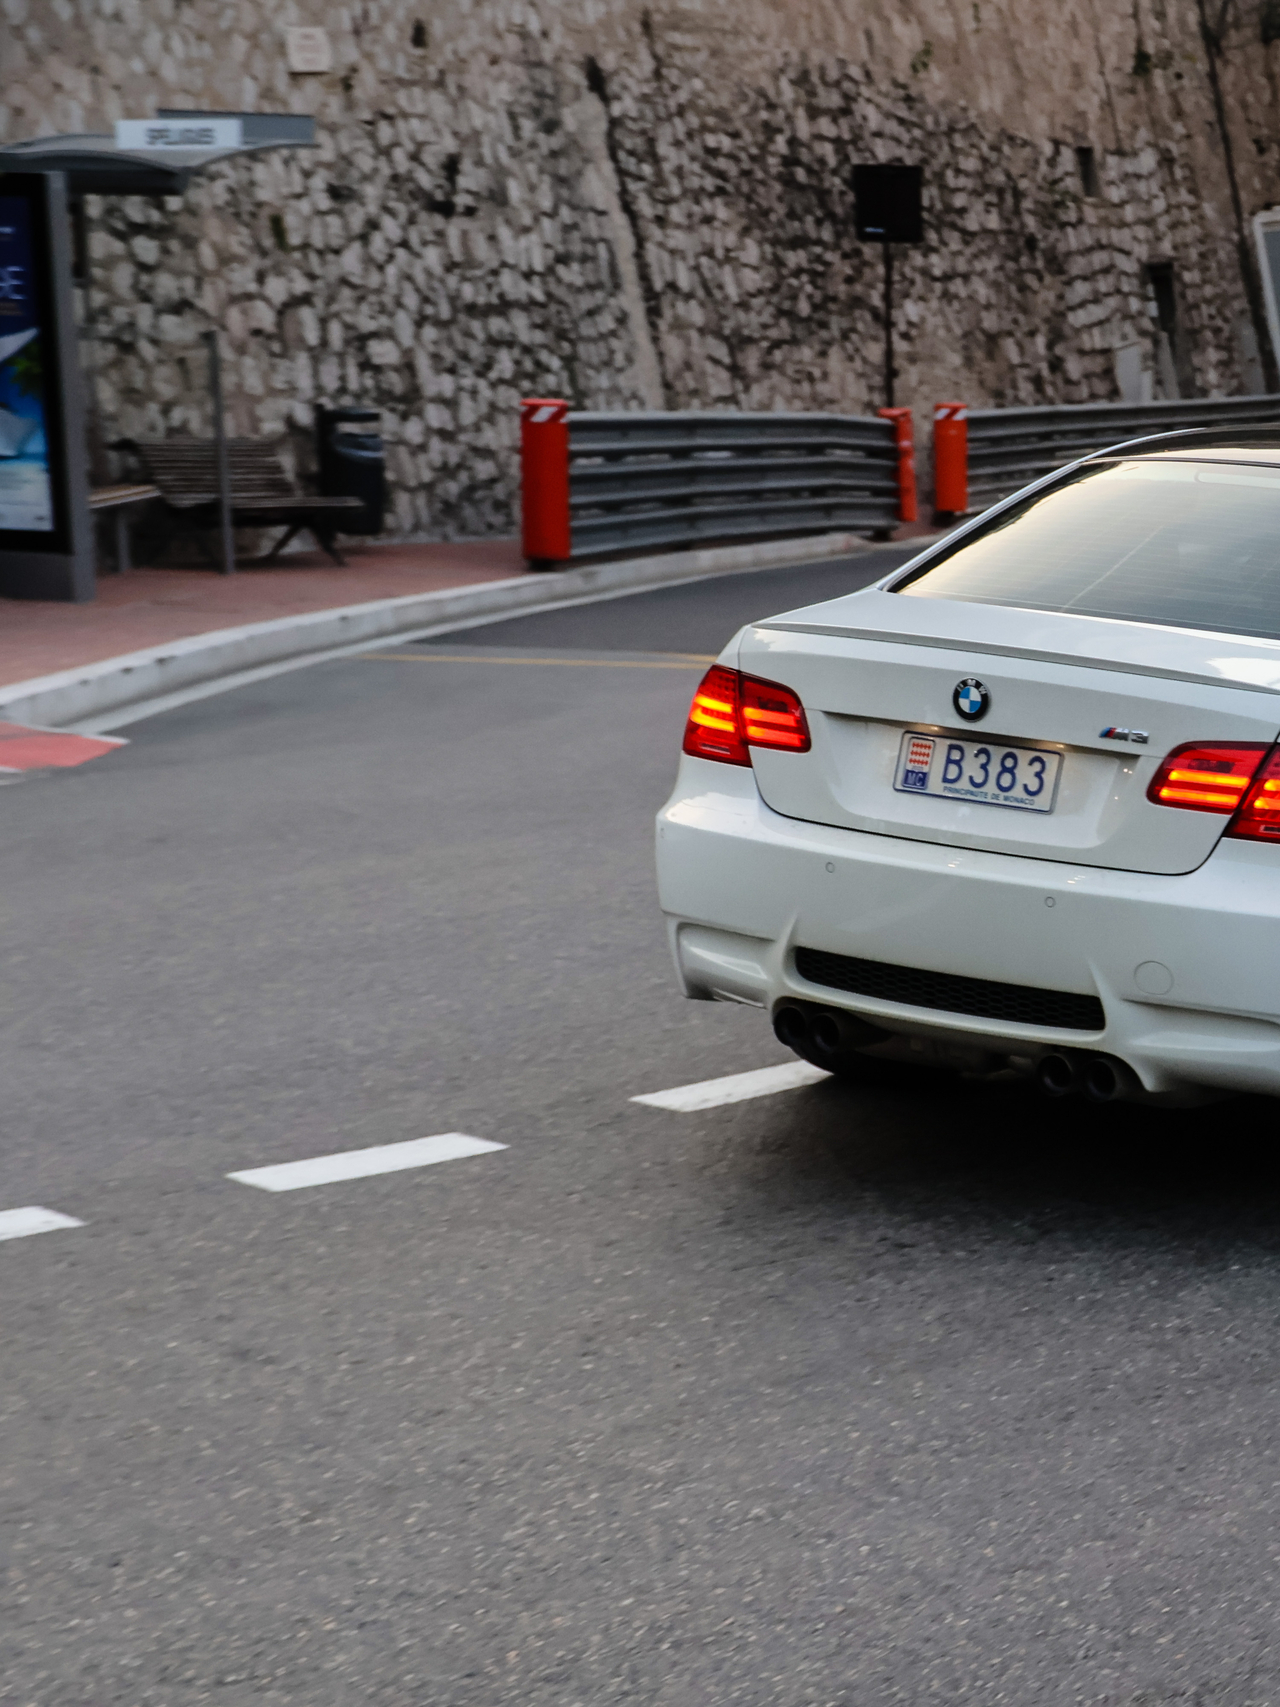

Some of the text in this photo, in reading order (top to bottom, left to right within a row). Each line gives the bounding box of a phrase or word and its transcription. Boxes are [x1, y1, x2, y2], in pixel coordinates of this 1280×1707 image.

[1099, 727, 1149, 744] M3
[942, 743, 1047, 797] B383
[906, 772, 925, 786] MC
[990, 792, 1001, 801] DE
[1003, 795, 1035, 806] MONACO
